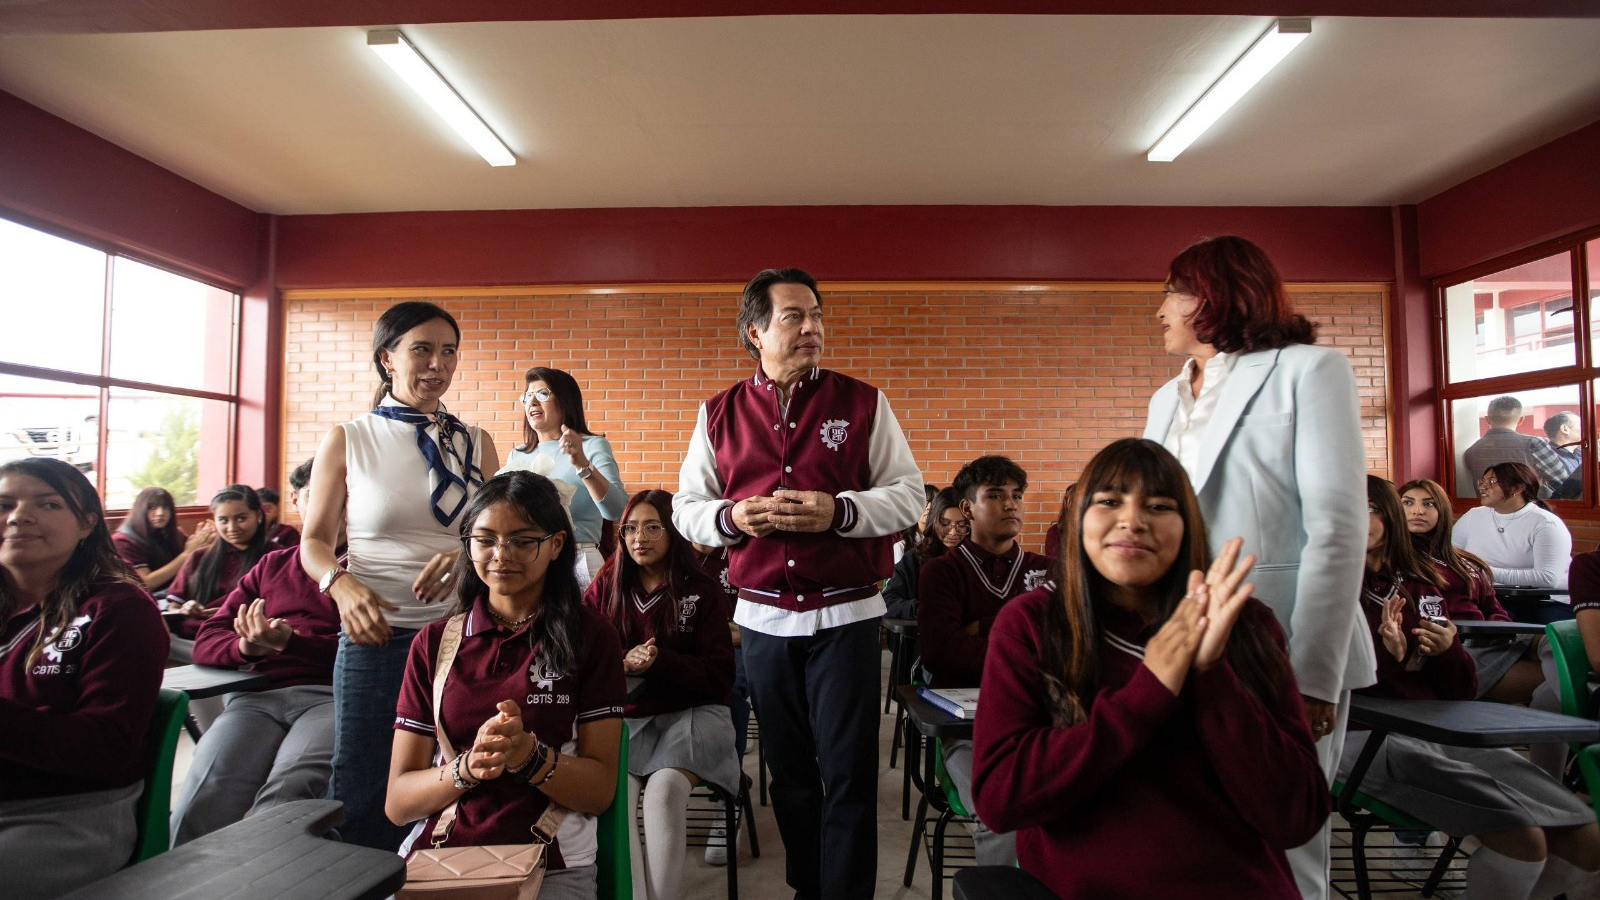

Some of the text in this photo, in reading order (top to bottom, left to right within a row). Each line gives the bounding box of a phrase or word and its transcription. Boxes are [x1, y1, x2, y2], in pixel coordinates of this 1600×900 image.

[32, 664, 60, 674] CBTIS
[526, 694, 570, 704] CBTIS 289
